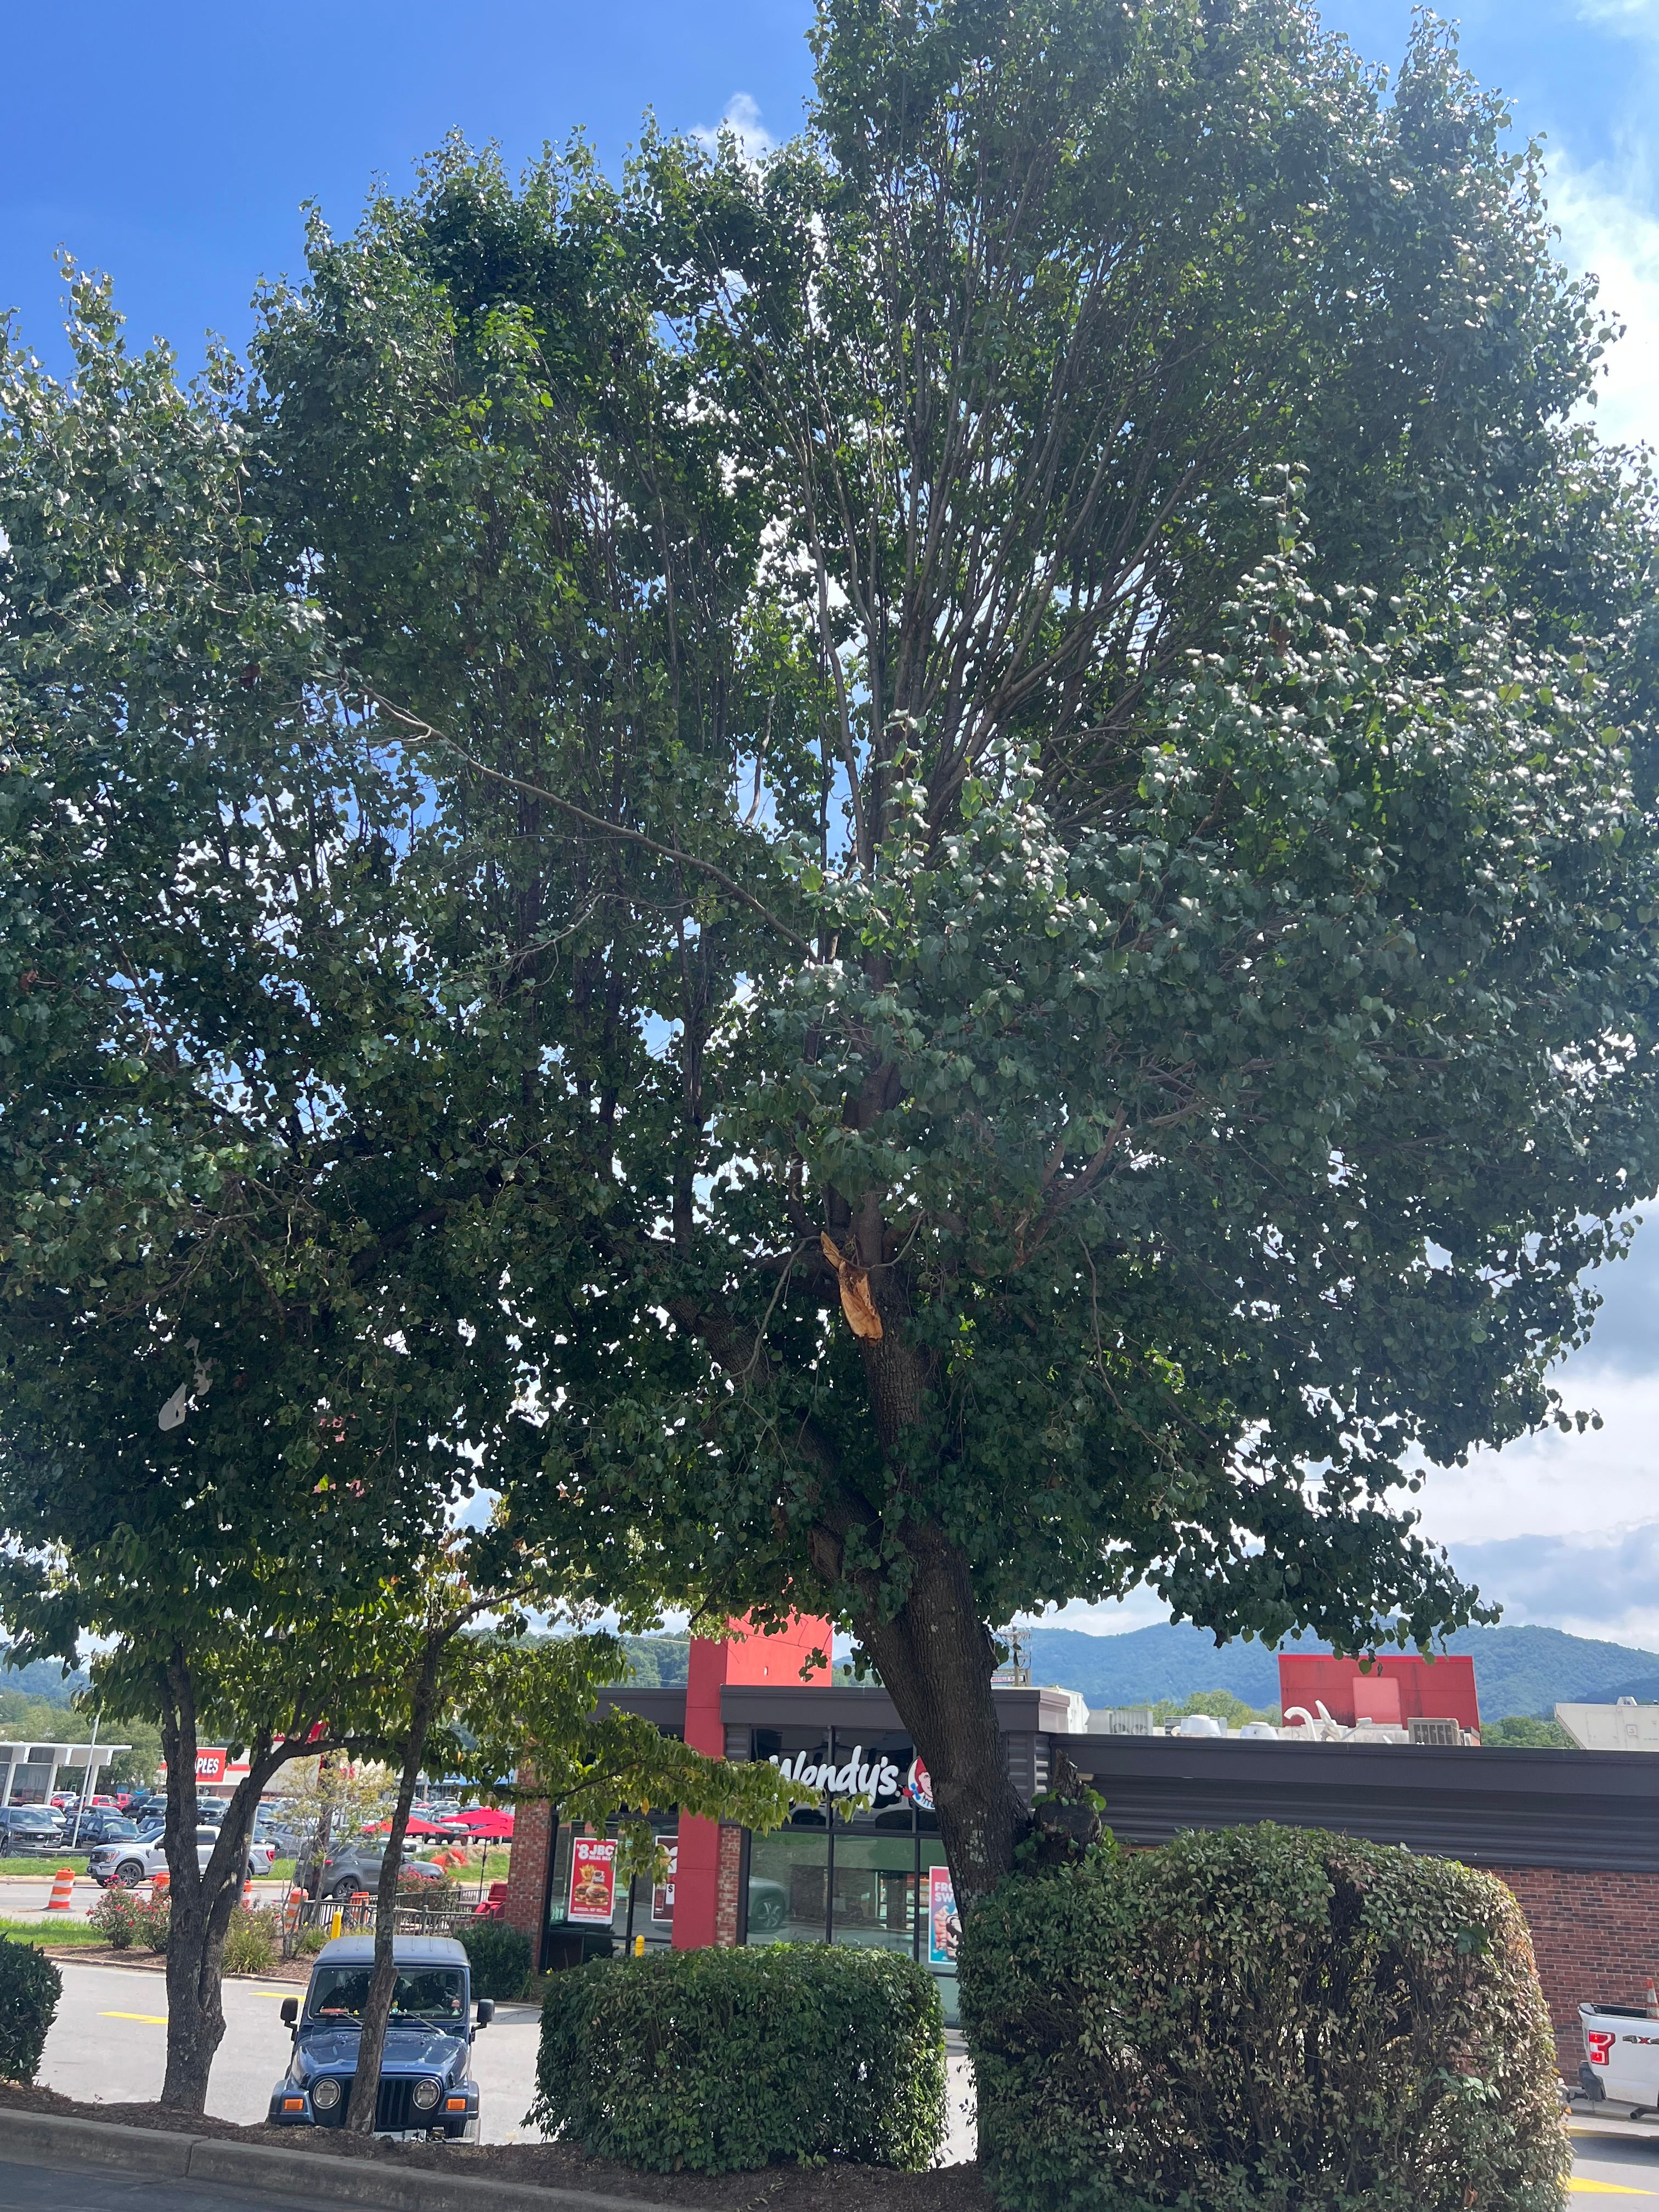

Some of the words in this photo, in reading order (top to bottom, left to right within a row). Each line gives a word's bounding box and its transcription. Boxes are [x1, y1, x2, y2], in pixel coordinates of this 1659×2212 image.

[195, 1757, 219, 1773] PLES
[769, 1745, 899, 1808] Wendy's
[589, 1844, 614, 1856] JBC
[934, 1881, 954, 1893] FRO
[934, 1892, 955, 1903] SW
